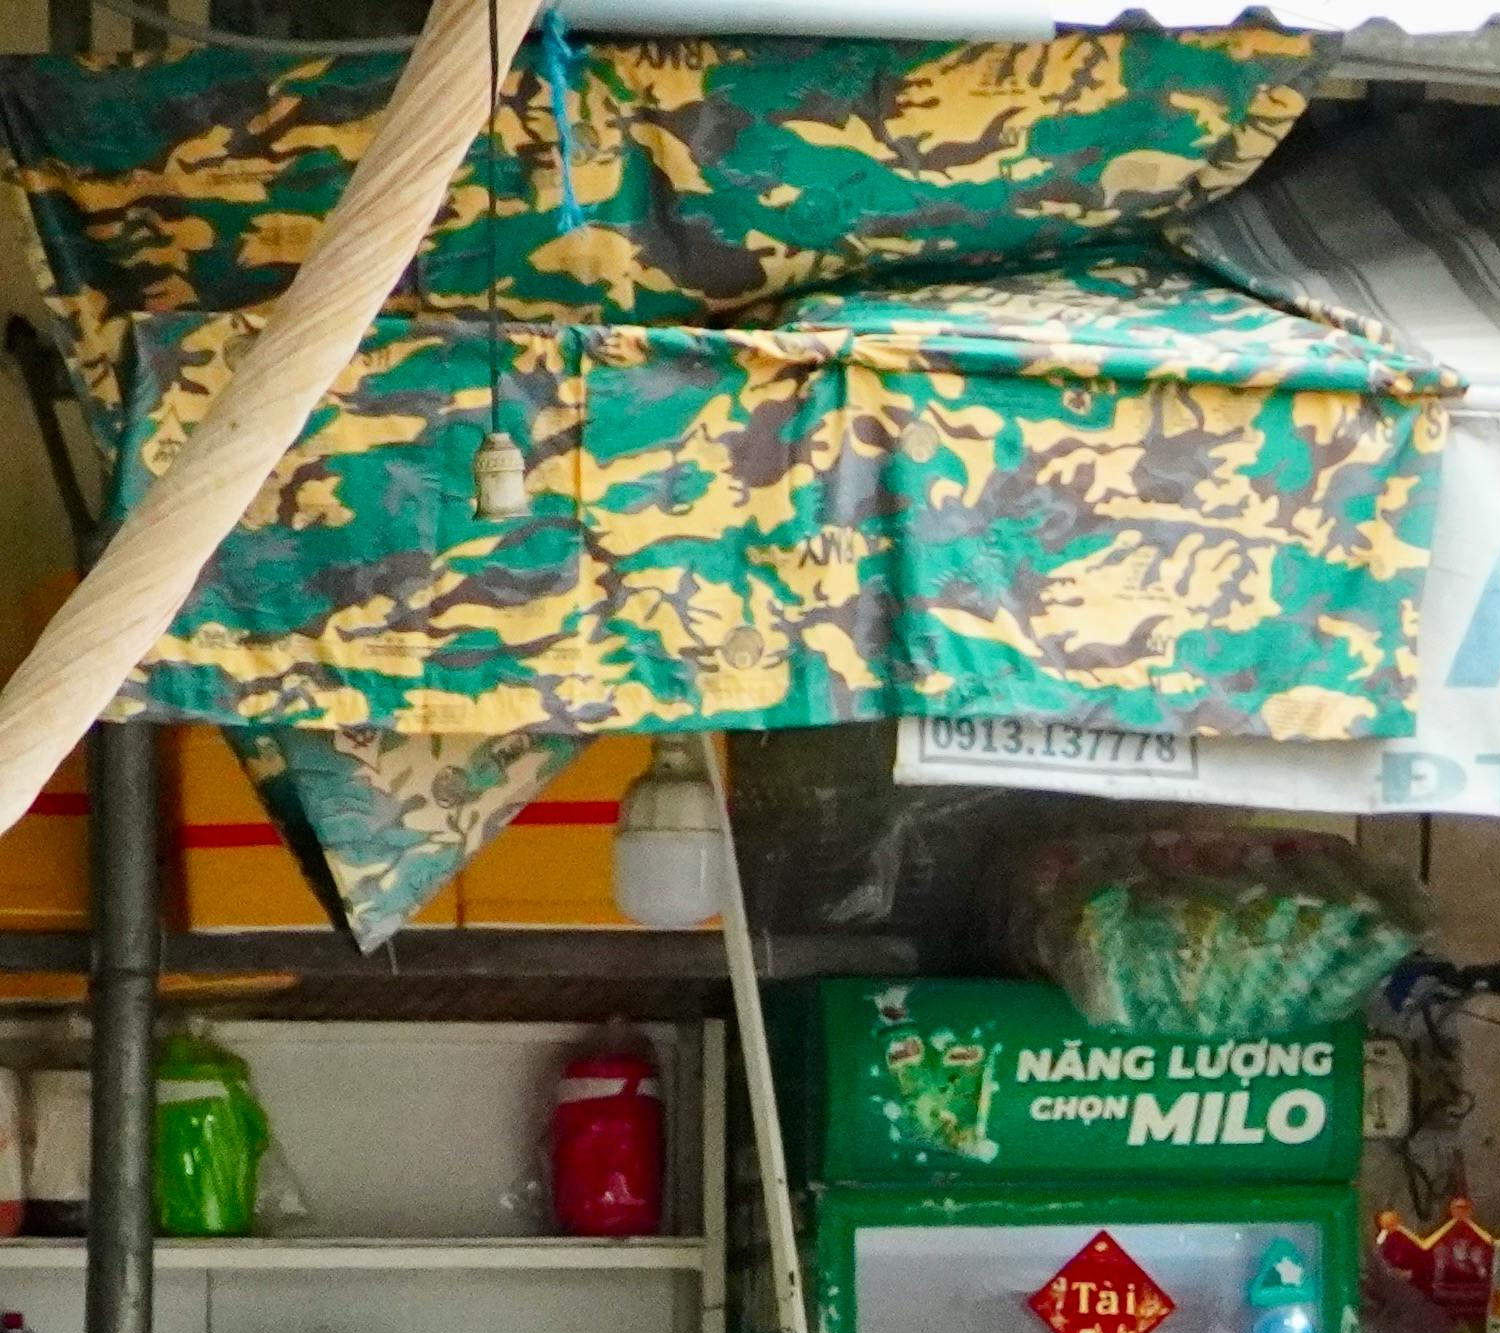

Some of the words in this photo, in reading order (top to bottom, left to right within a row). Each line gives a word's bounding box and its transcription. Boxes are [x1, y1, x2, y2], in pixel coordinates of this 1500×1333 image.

[1017, 1039, 1155, 1084] NĂNG
[1168, 1039, 1334, 1087] LƯỢNG
[1030, 1094, 1128, 1122] CHỌN
[1127, 1089, 1327, 1146] MILO
[1071, 1281, 1136, 1316] Tài
